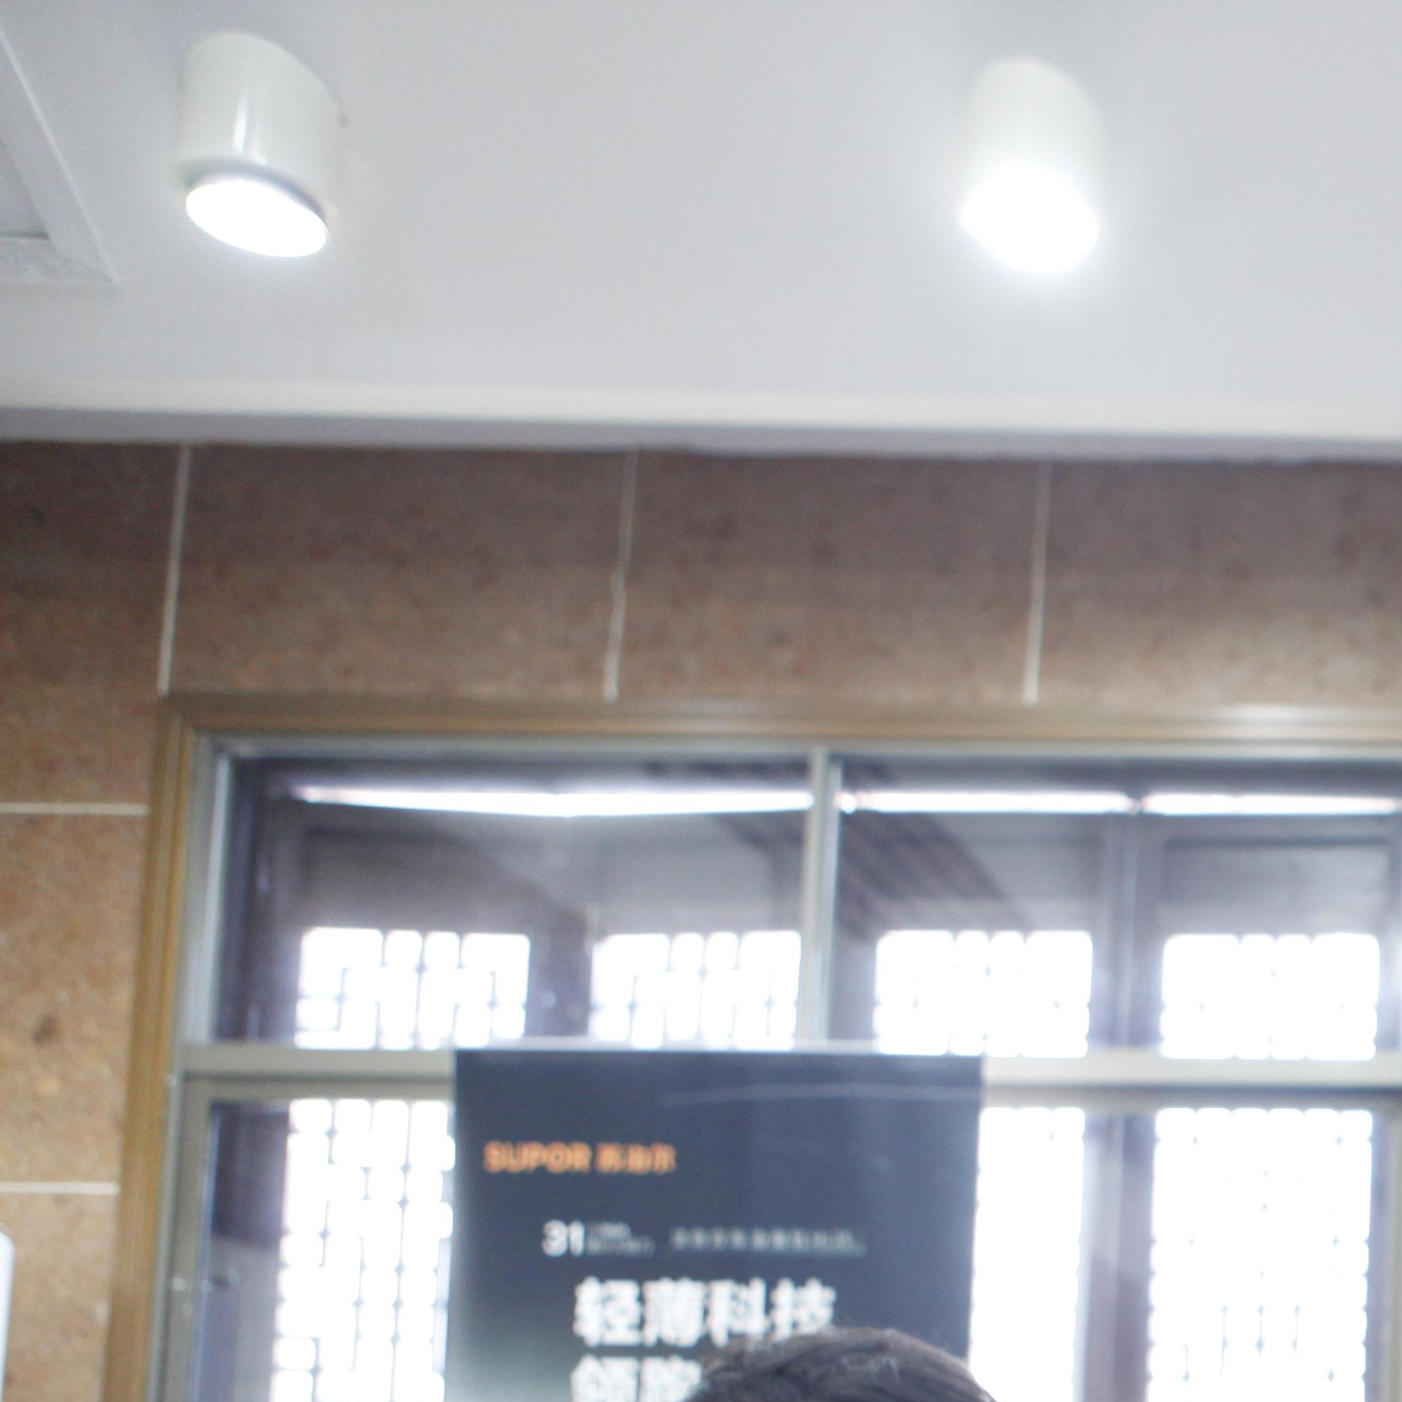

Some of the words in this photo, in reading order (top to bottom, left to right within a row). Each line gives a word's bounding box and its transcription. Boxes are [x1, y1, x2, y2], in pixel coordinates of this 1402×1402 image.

[483, 1141, 592, 1173] SUPOR
[542, 1221, 584, 1257] 31
[573, 1277, 836, 1347] 轻薄科技
